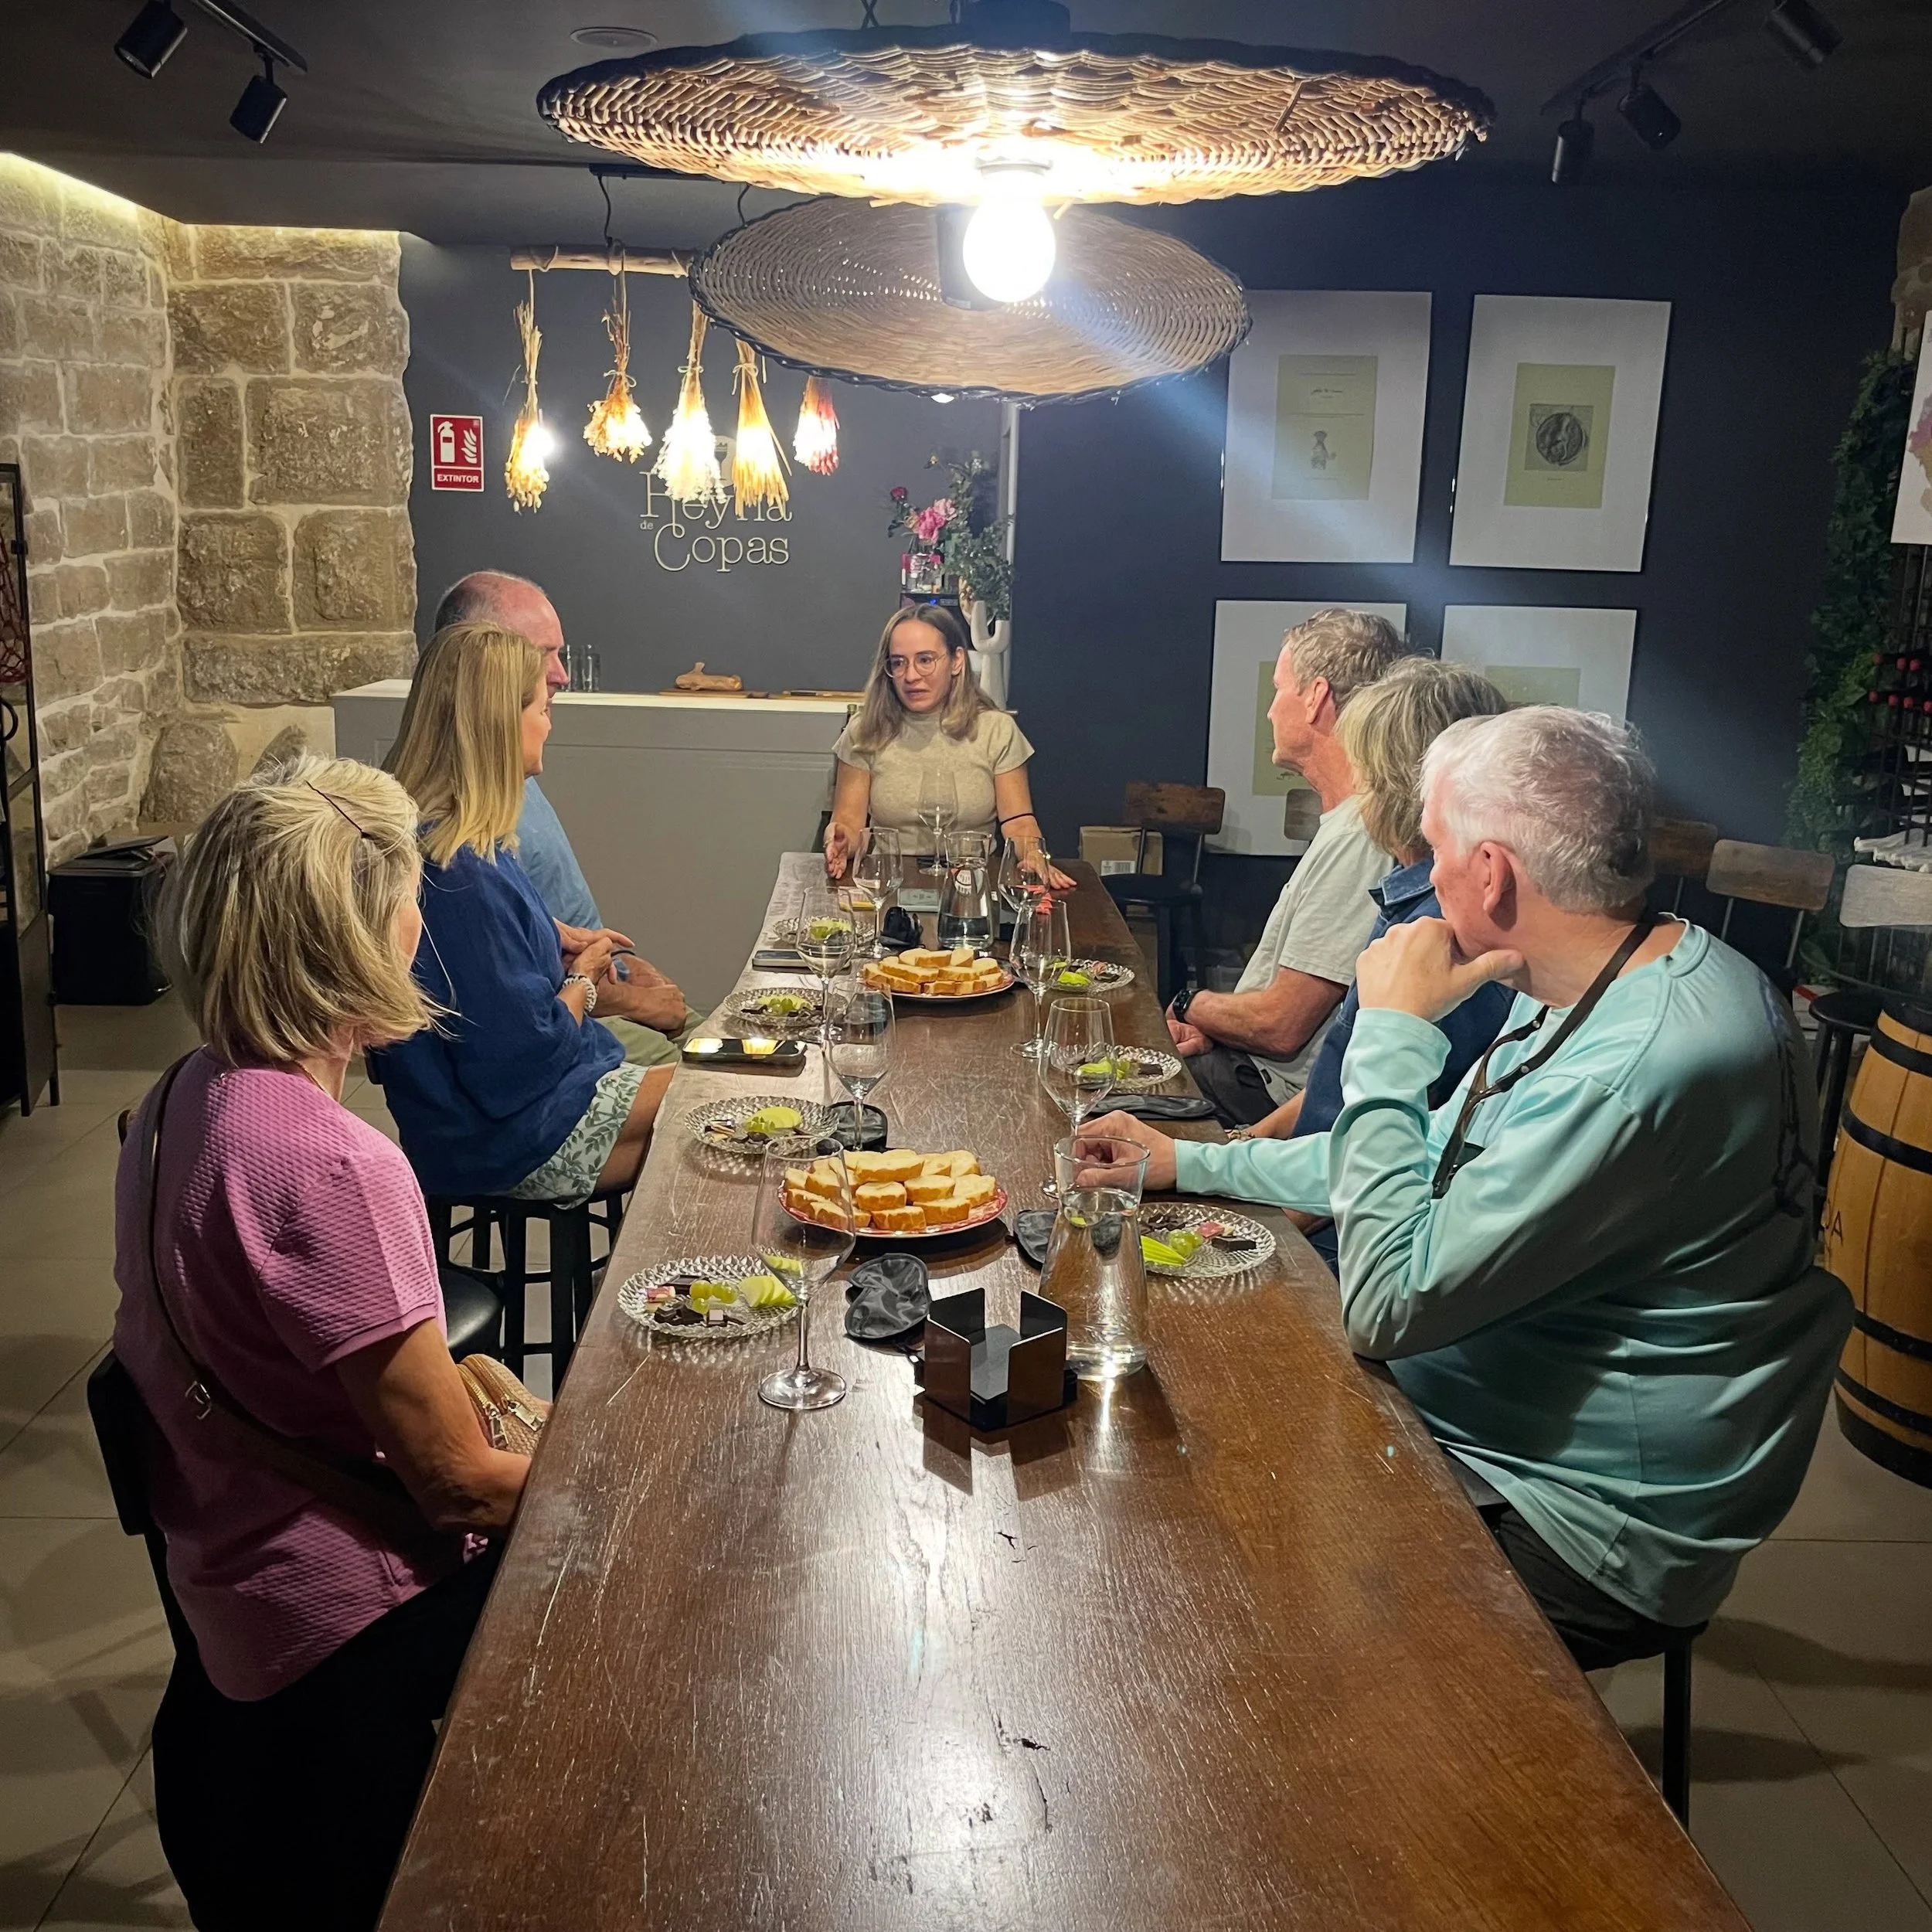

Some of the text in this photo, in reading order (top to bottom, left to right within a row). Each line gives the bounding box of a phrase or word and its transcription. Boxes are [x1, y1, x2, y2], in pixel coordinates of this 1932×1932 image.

[437, 474, 479, 483] EXTINTOR
[640, 520, 654, 530] de
[655, 523, 789, 572] Copas
